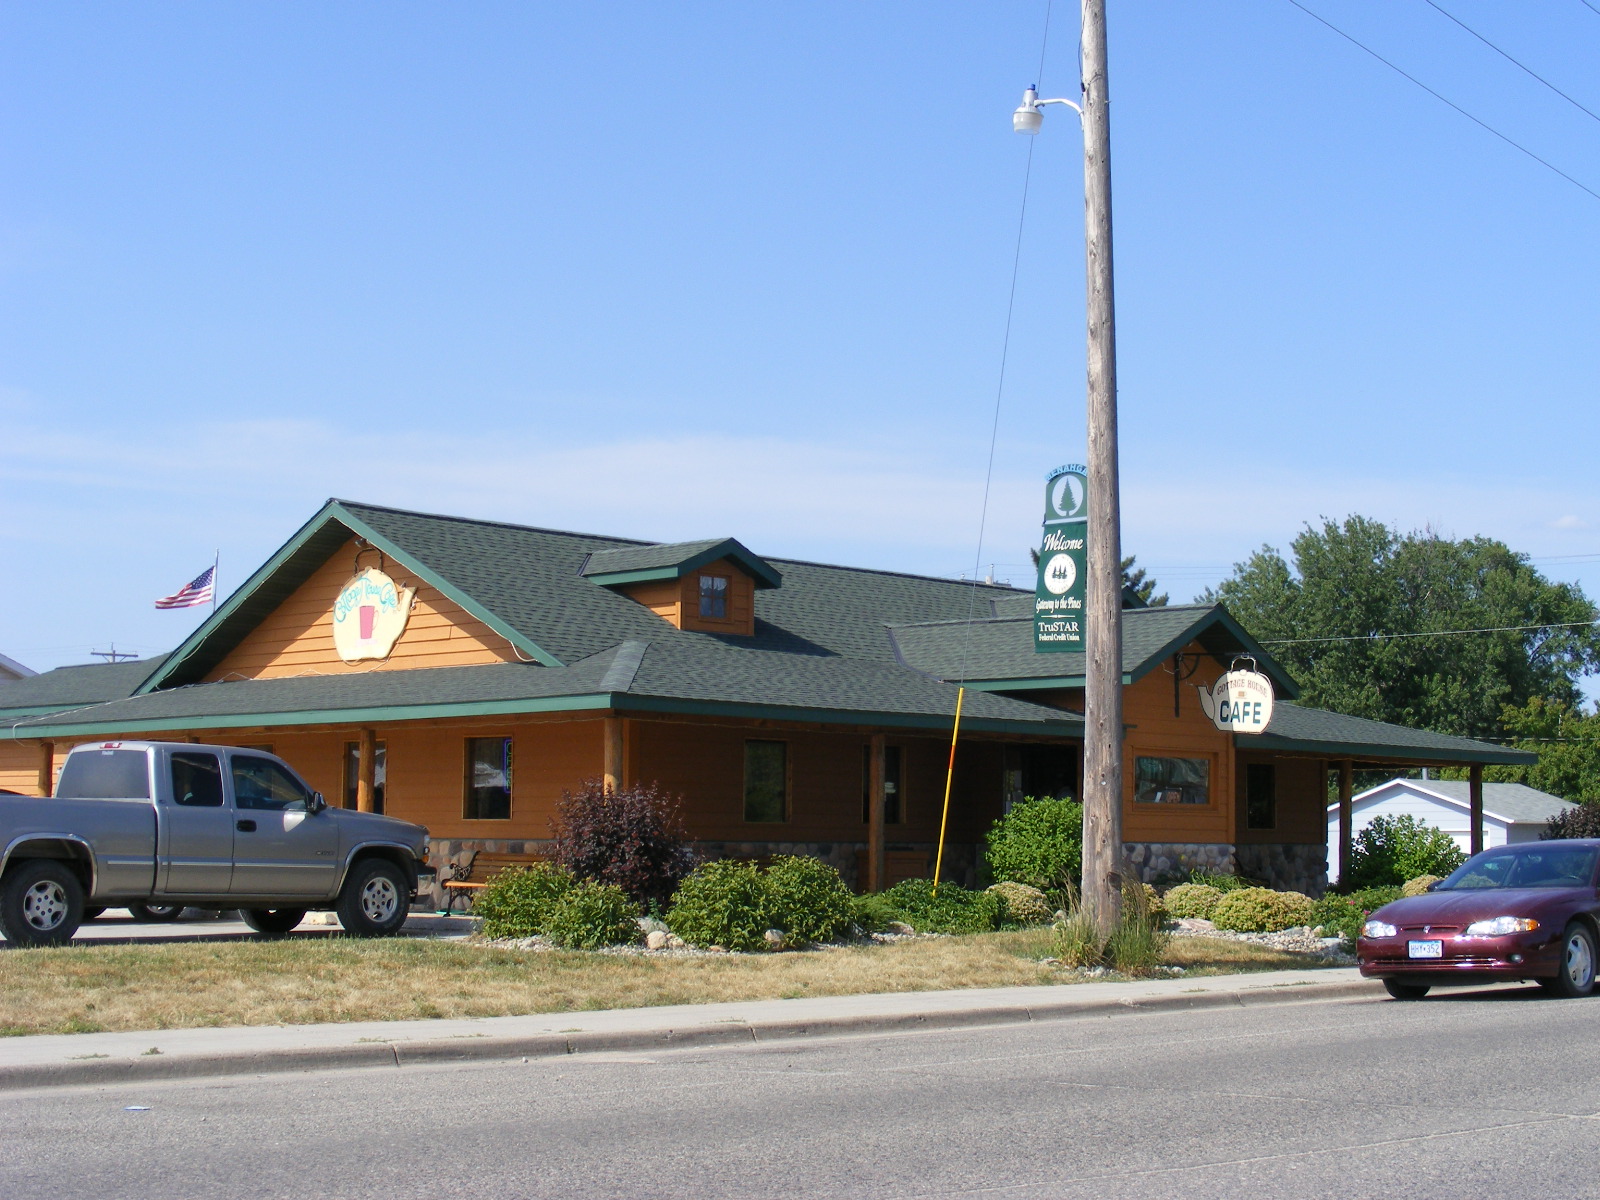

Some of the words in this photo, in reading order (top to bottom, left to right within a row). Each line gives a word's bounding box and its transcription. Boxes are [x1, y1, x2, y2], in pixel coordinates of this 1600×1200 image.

[1043, 529, 1083, 551] Welcome
[1054, 598, 1060, 609] to
[1068, 596, 1081, 609] Pines
[1038, 621, 1079, 632] TruSTAR
[1038, 633, 1054, 641] Federal
[1053, 633, 1066, 641] Credit
[1066, 633, 1080, 641] Union
[1217, 679, 1245, 696] COTTAGE
[1247, 679, 1268, 698] HOUSE
[1220, 700, 1262, 724] CAFE
